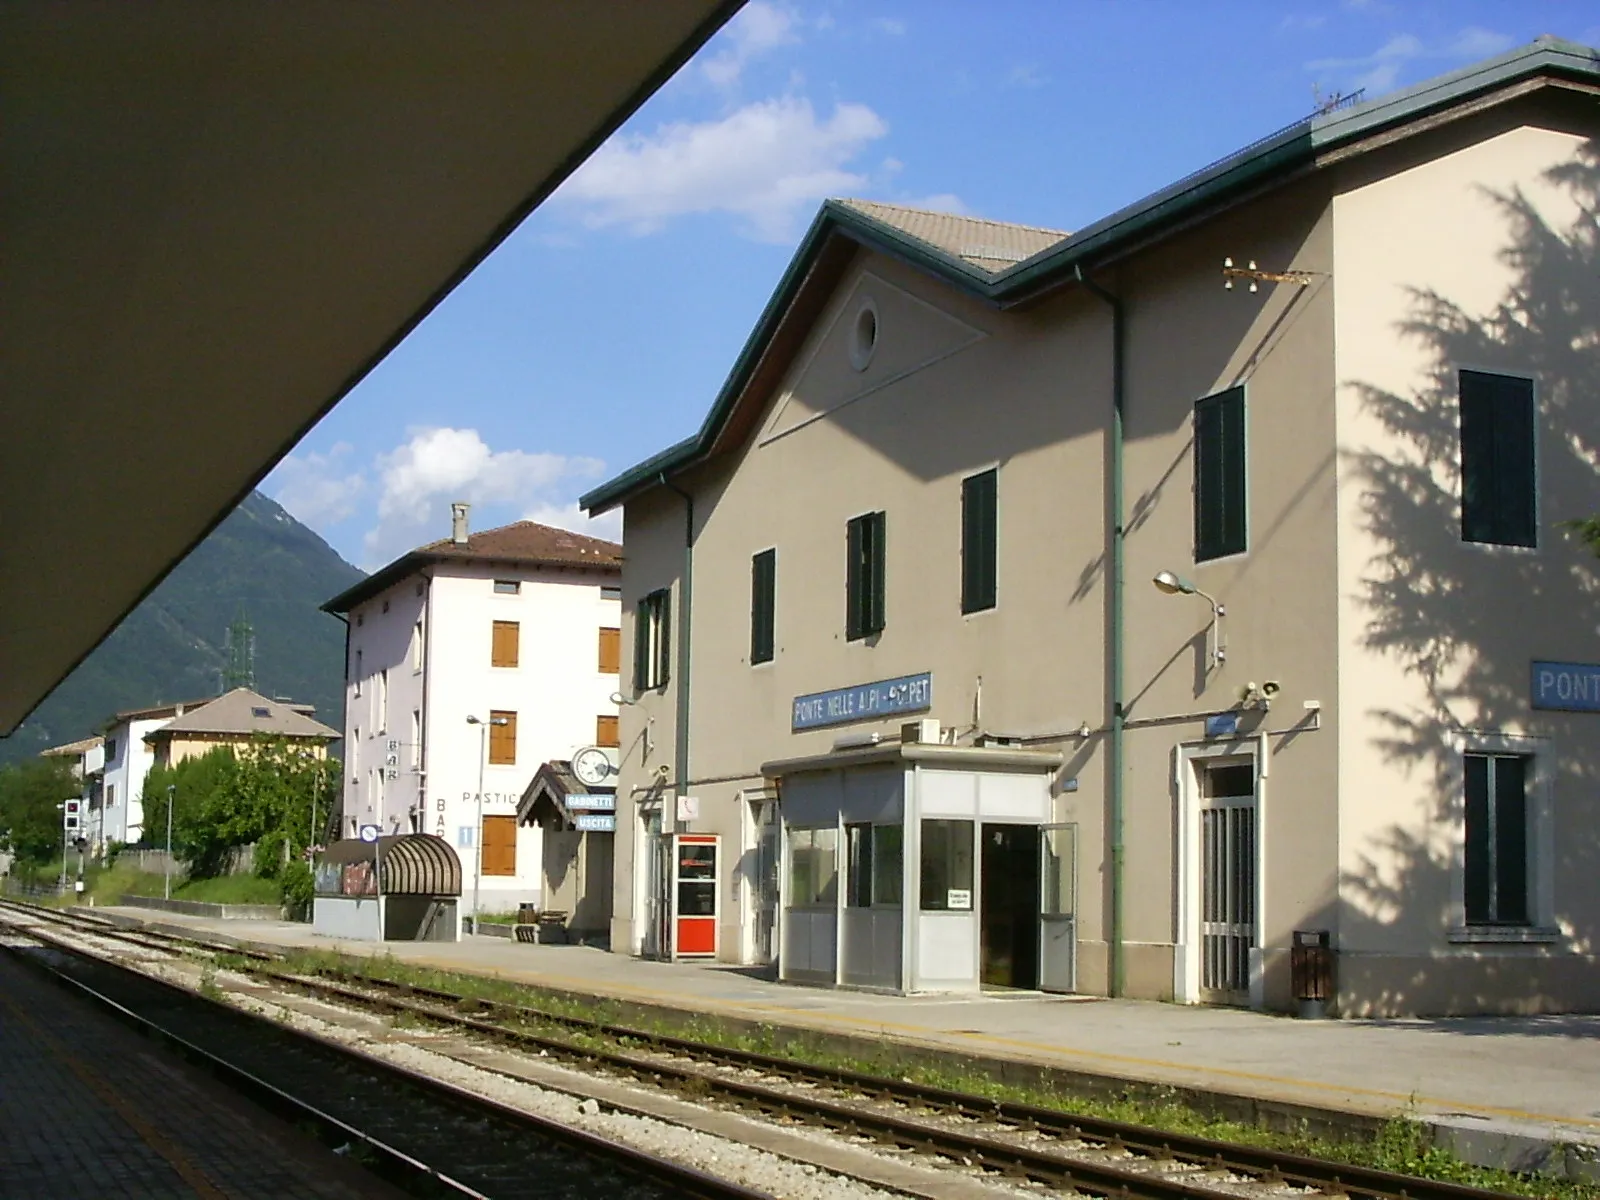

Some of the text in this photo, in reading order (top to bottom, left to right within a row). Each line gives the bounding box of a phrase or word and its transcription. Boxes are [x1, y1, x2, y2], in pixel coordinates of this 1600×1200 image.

[795, 699, 823, 722] PONTE
[827, 693, 853, 716] NELLE
[859, 689, 879, 711] ALPI
[462, 792, 521, 804] PASTIC
[579, 818, 611, 829] USCITA
